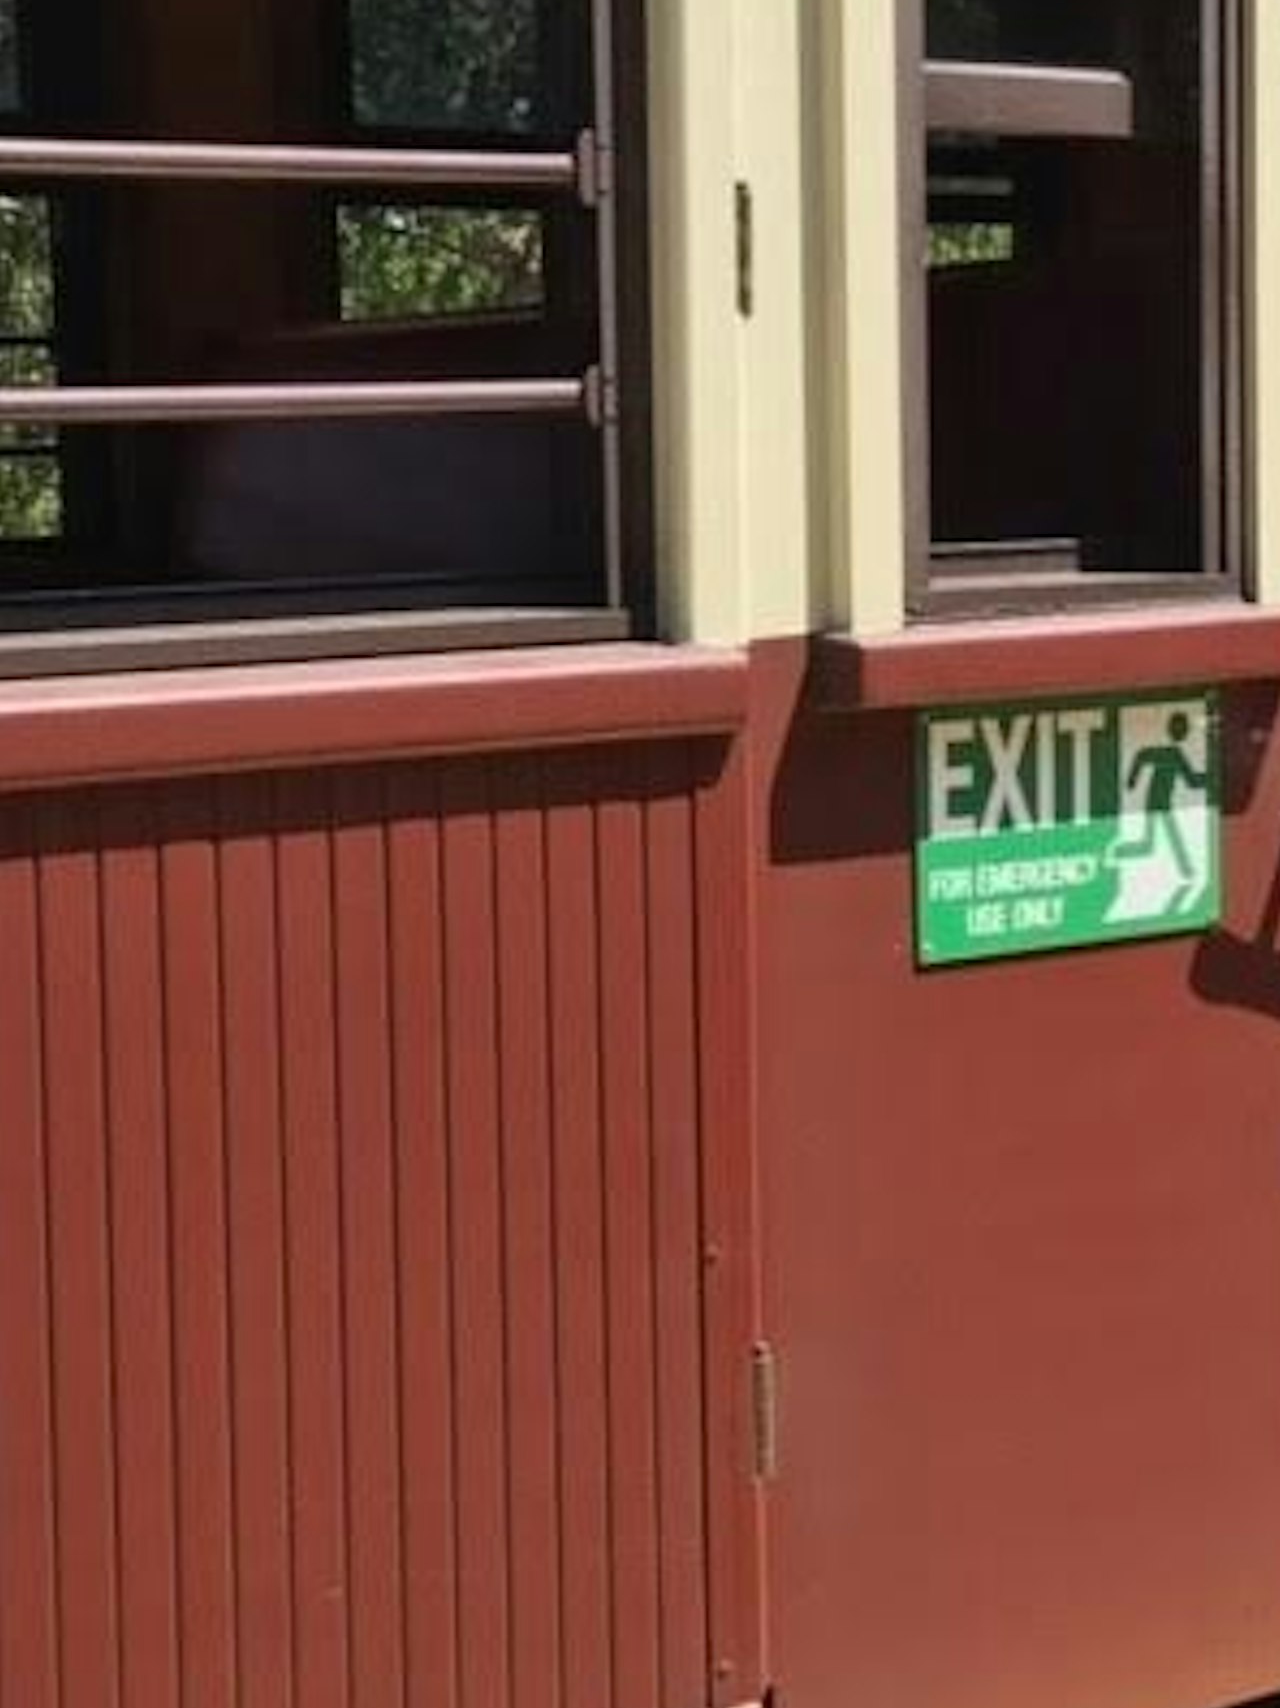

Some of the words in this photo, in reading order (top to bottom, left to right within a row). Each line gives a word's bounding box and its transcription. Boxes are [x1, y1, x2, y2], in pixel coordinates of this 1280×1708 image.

[928, 708, 1106, 840] EXIT
[928, 868, 972, 903] FOR
[975, 855, 1098, 898] EMERGENCY
[967, 902, 1006, 936] USE
[1011, 895, 1064, 930] ONLY
